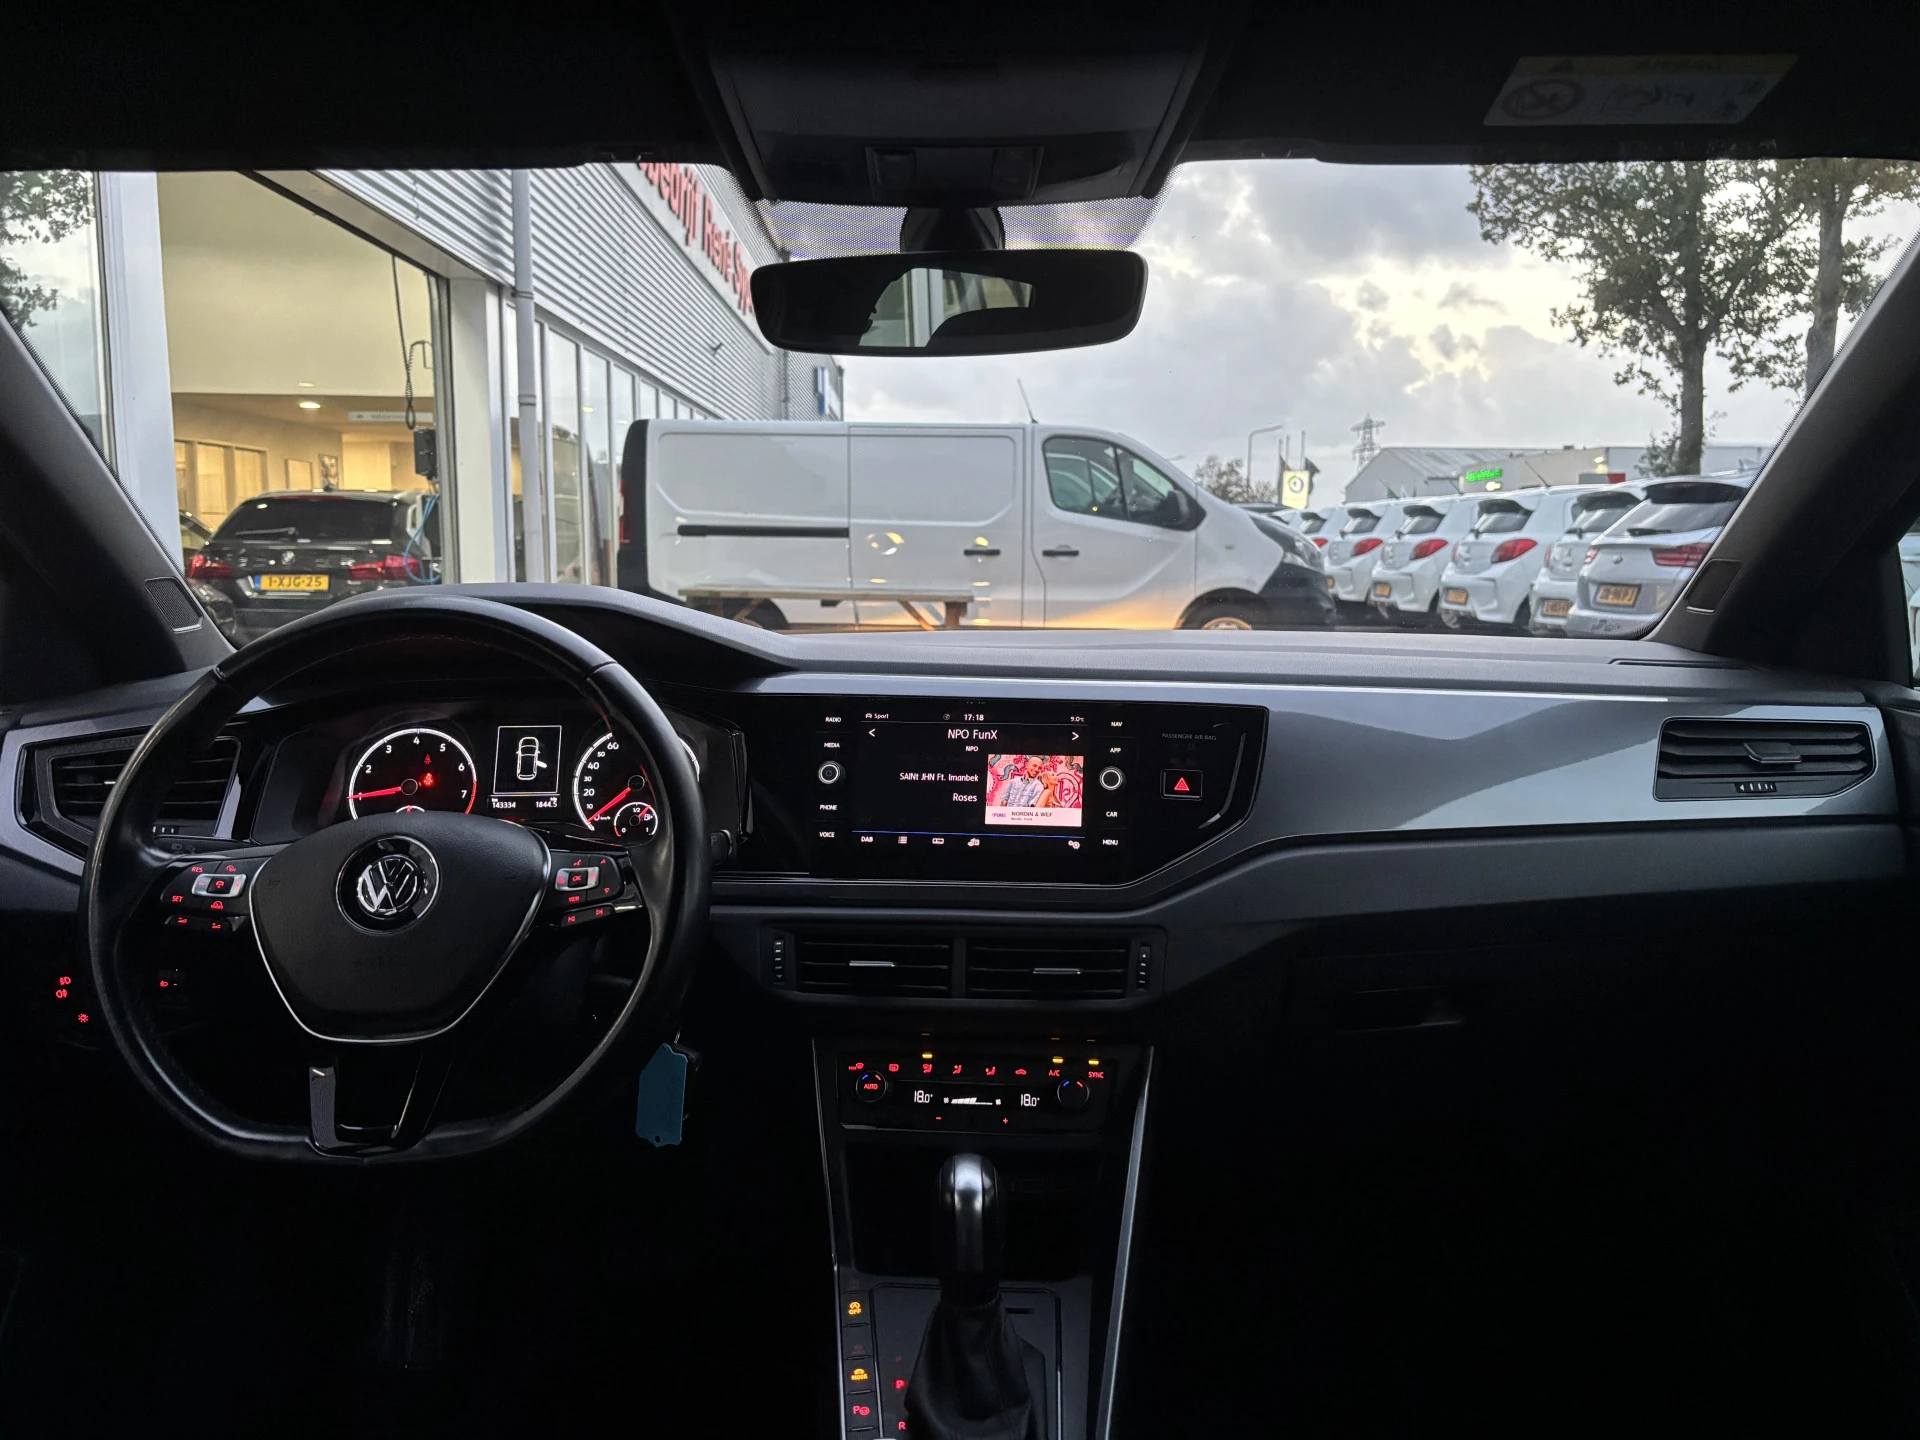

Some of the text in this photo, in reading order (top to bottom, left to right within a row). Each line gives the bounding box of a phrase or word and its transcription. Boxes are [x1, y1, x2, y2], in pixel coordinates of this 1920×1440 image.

[702, 195, 732, 283] René
[948, 729, 997, 739] NPO FunX
[386, 745, 391, 753] 3
[366, 765, 371, 773] 2
[458, 763, 464, 771] 6
[462, 790, 467, 798] 7
[953, 793, 977, 801] Roses
[171, 895, 184, 903] SET
[895, 1380, 905, 1389] P
[853, 1405, 860, 1415] P
[899, 1422, 905, 1430] R
